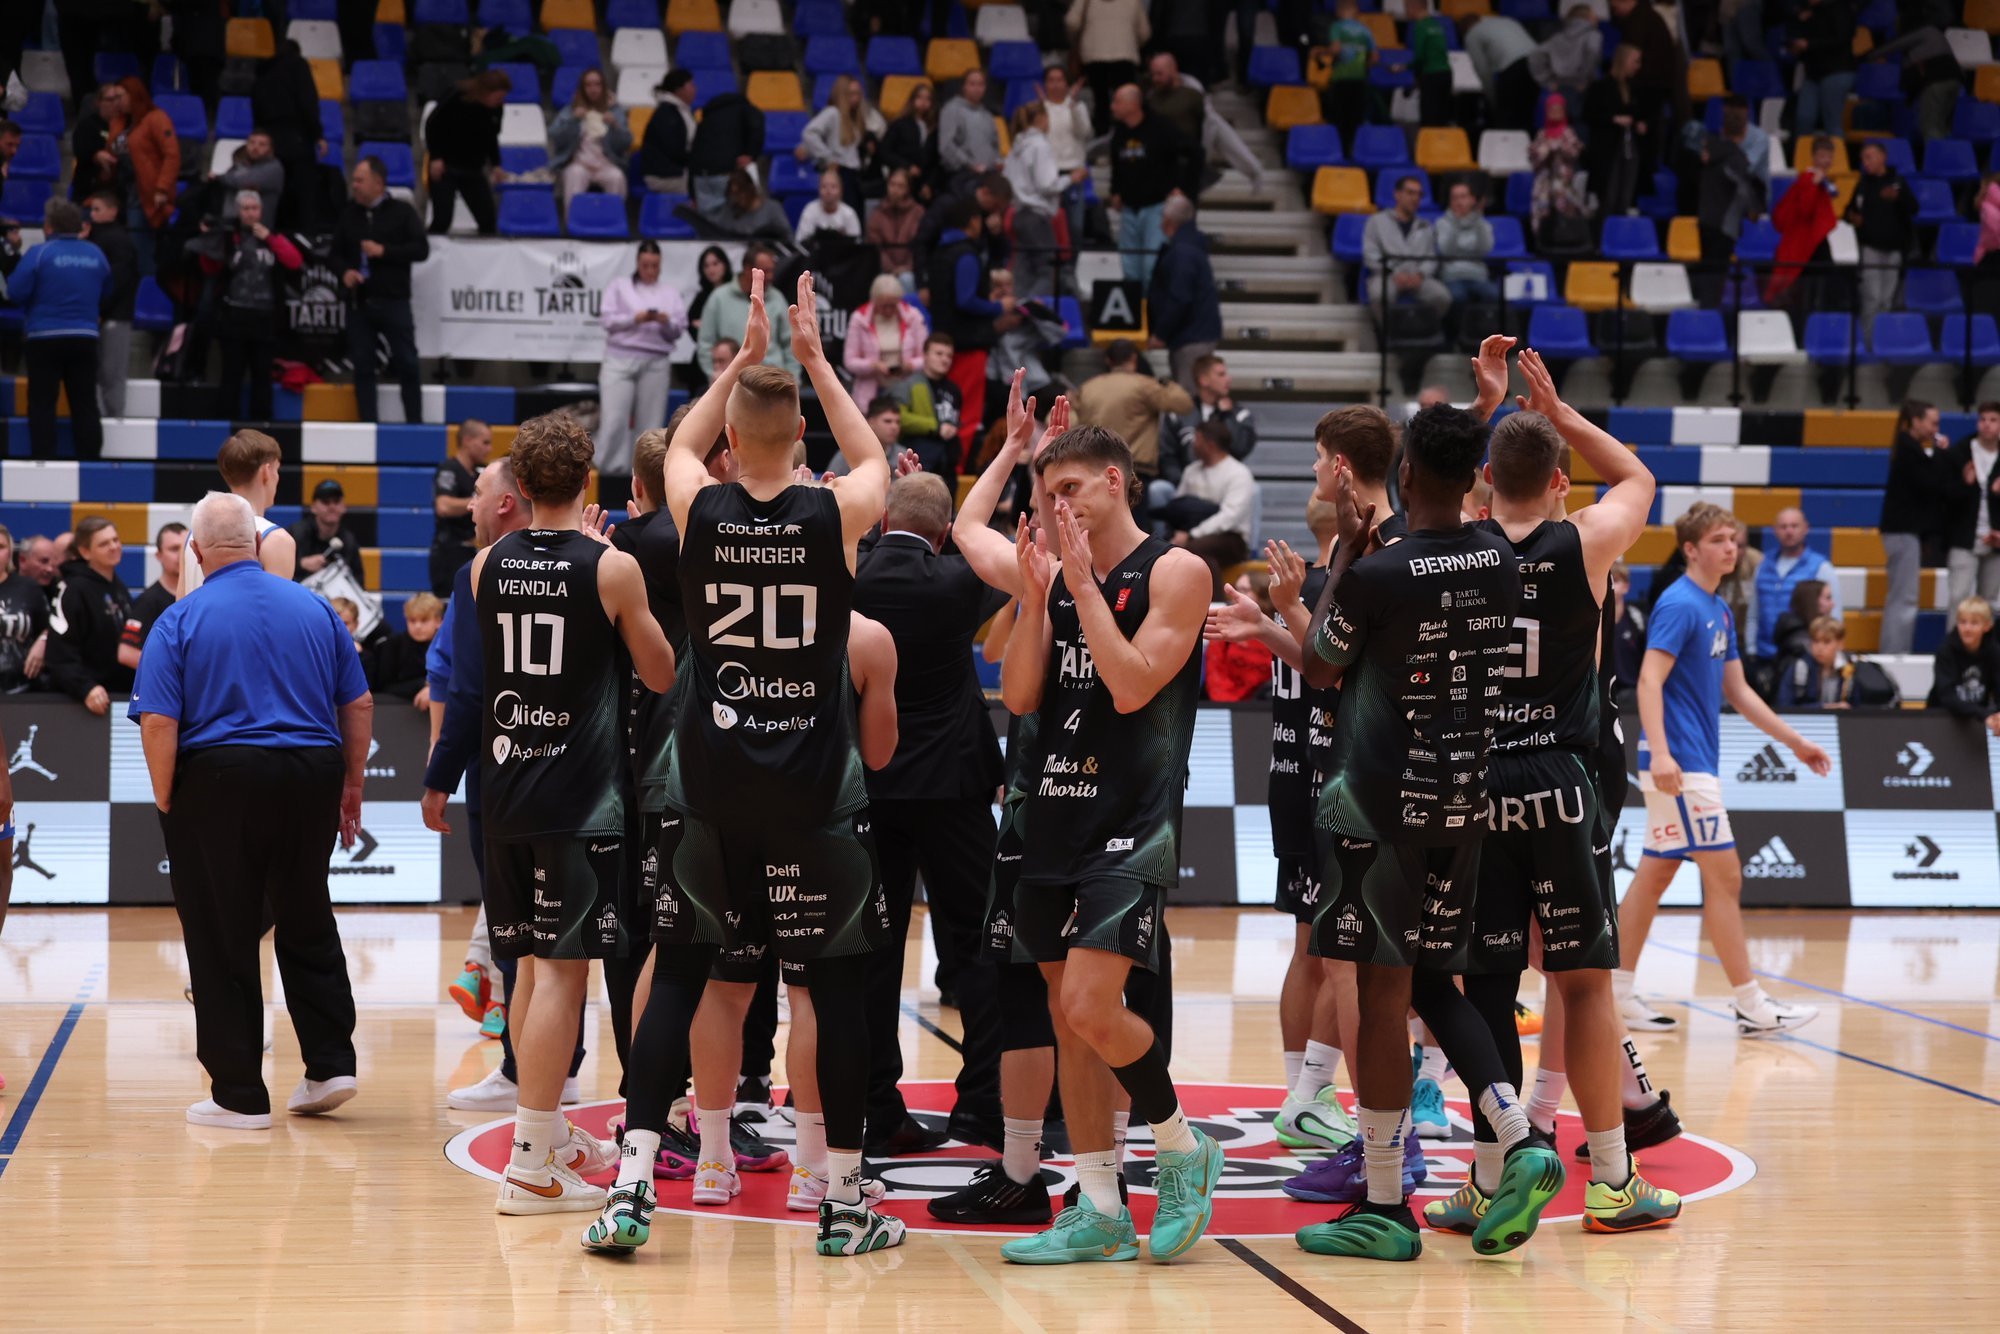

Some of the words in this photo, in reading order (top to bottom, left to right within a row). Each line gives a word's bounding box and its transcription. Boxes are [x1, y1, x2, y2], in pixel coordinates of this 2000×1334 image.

[451, 285, 524, 312] VÕITLE!
[535, 287, 601, 317] TARTU
[1101, 287, 1134, 324] A
[717, 522, 782, 536] COOLBET
[715, 546, 806, 564] NURGER
[1409, 549, 1500, 577] BERNARD
[501, 558, 554, 571] COOLBET
[499, 579, 568, 597] VENDLA
[1455, 589, 1479, 599] TARTU
[1455, 597, 1488, 608] ÜLIKOOL
[705, 583, 817, 649] 20
[1419, 620, 1440, 632] Maks
[1441, 619, 1448, 628] &
[497, 612, 565, 676] 10
[1418, 631, 1448, 641] Moorits
[1055, 640, 1100, 682] TAR
[716, 661, 816, 700] Midea
[494, 690, 570, 729] Midea
[744, 715, 816, 733] A-pellet
[1064, 709, 1081, 735] 4
[1273, 723, 1296, 743] idea
[1044, 754, 1078, 774] Maks
[1082, 756, 1098, 774] &
[1039, 777, 1098, 798] Moorits
[1405, 791, 1439, 800] PENETRON
[1488, 785, 1585, 832] RTU
[1403, 816, 1425, 824] ZEBRA
[1696, 816, 1719, 842] 17
[766, 864, 800, 877] Delfi
[769, 885, 797, 902] LUX
[799, 893, 827, 903] Express
[656, 899, 678, 914] TARTU
[1423, 896, 1443, 915] UX
[1553, 907, 1580, 917] Express
[990, 922, 1013, 937] TARTU
[1337, 918, 1363, 934] TARTU
